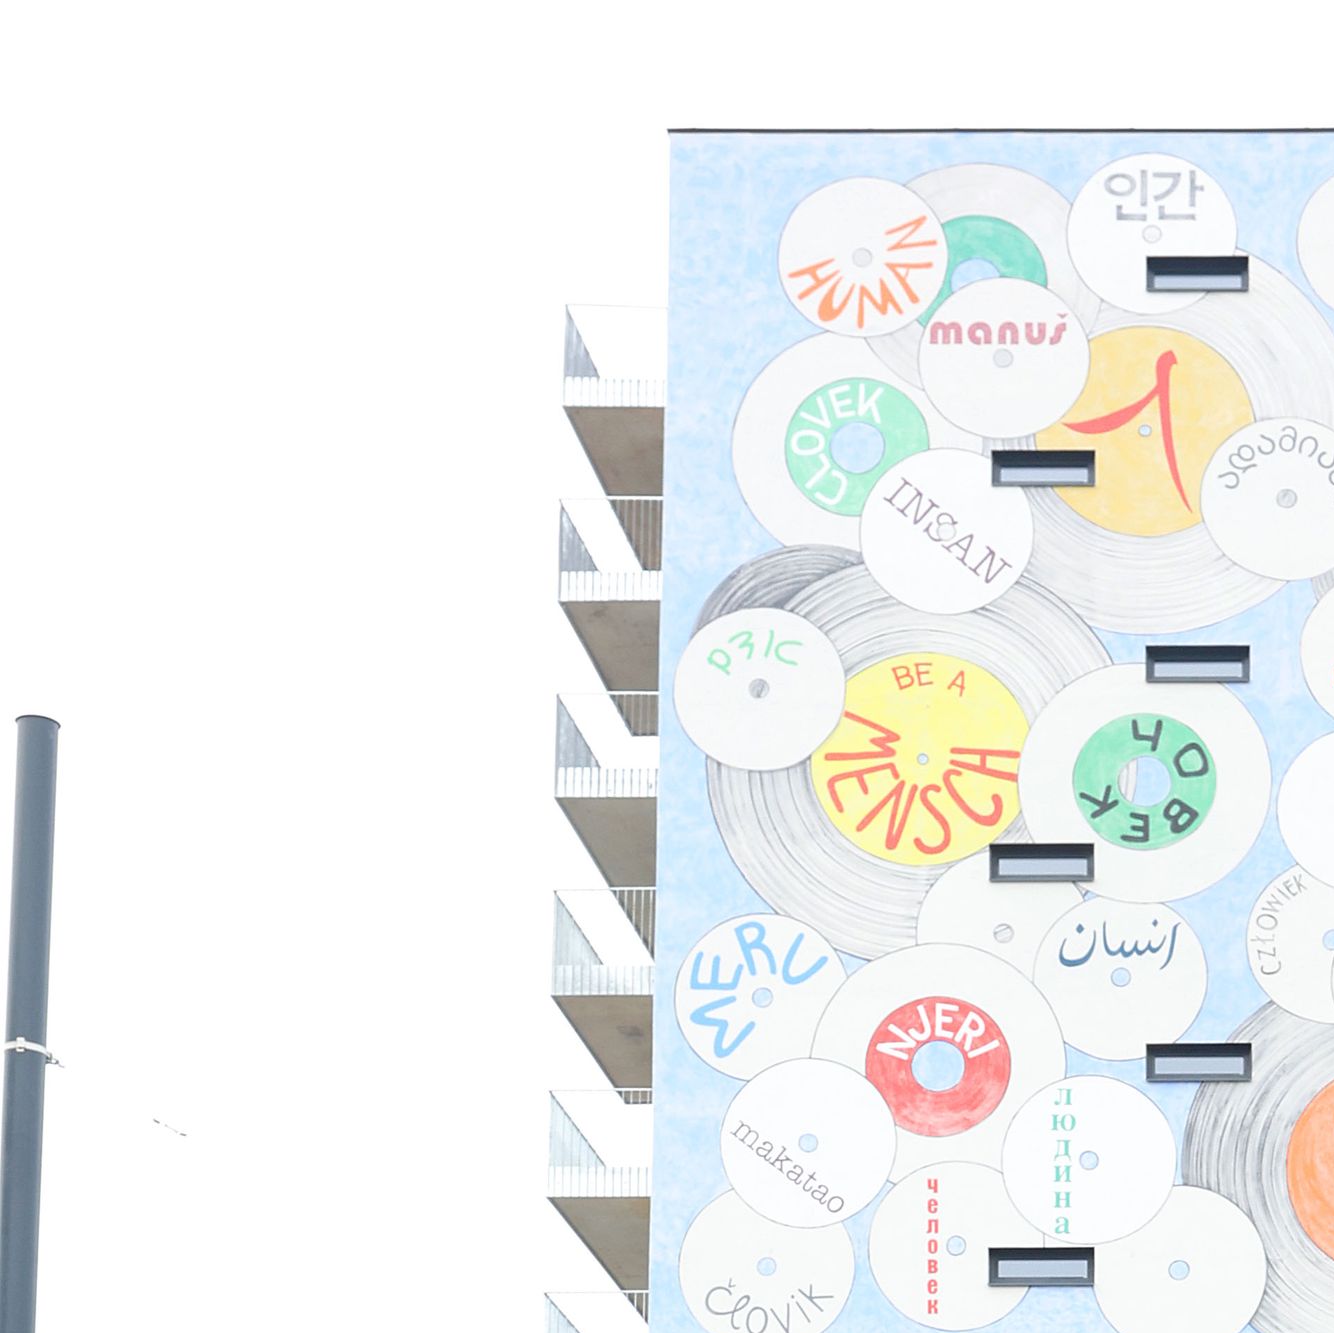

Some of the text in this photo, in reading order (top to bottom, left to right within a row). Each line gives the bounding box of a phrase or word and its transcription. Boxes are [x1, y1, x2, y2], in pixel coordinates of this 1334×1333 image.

[1104, 169, 1205, 221] 인간
[788, 215, 937, 328] HUMAN
[929, 313, 1068, 345] manuš
[1061, 349, 1193, 514] 人
[892, 662, 965, 697] BE A
[824, 710, 1021, 854] MENSCH
[1058, 918, 1181, 970] انسان
[876, 1002, 1000, 1061] NJERI
[730, 1120, 845, 1213] makatao
[926, 1178, 939, 1315] человек
